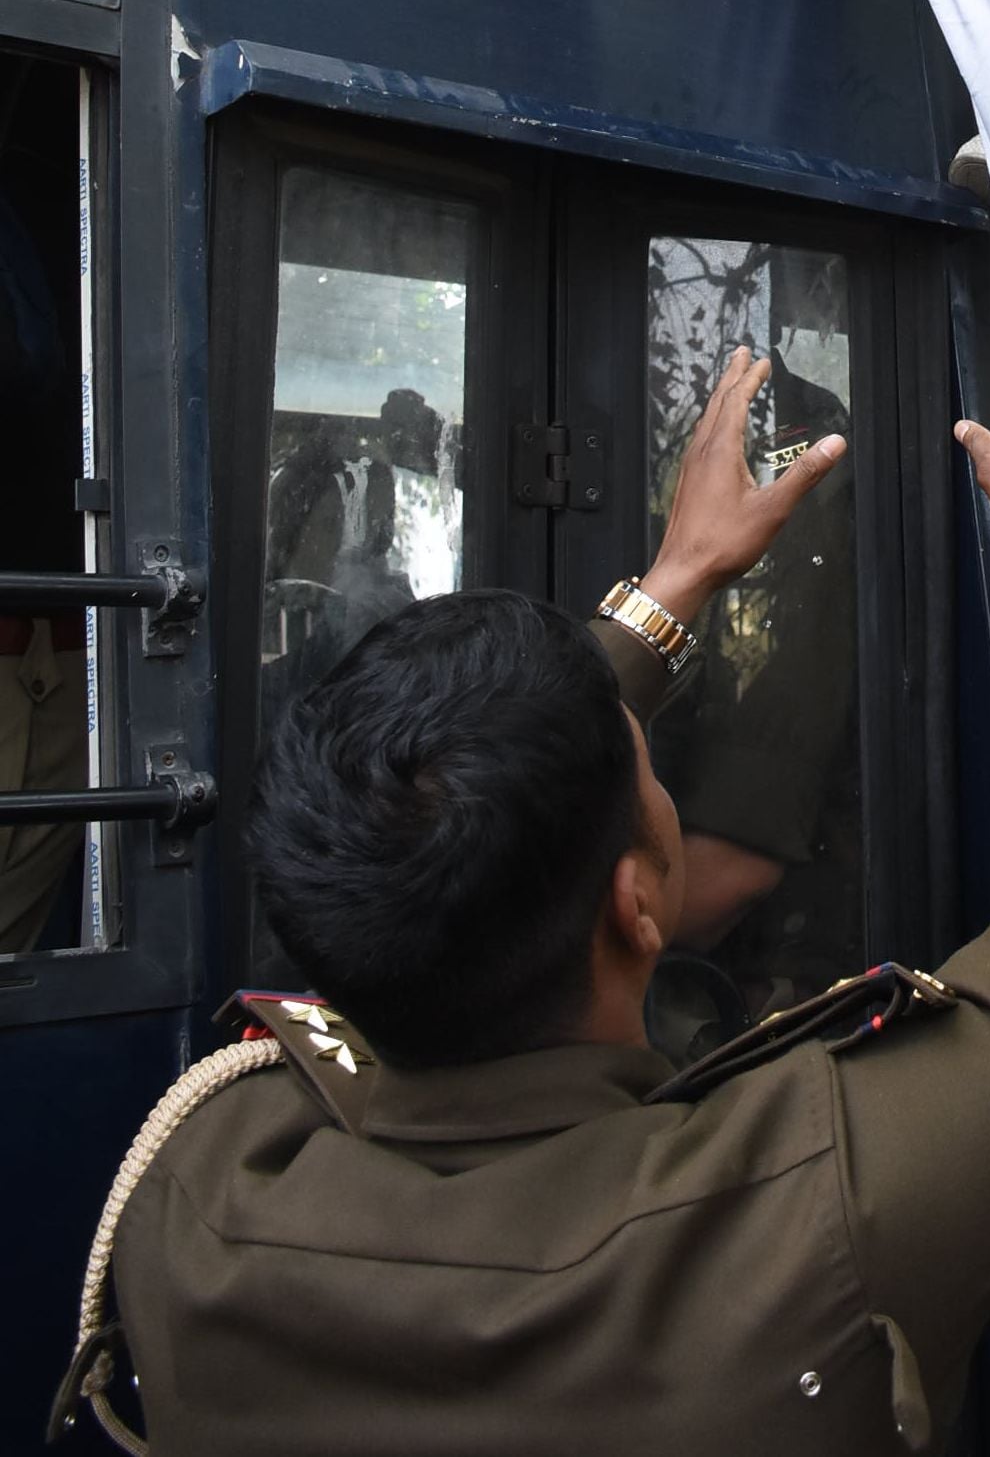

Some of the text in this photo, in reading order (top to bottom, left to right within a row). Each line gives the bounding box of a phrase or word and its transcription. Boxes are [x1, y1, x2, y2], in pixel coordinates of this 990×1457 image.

[79, 158, 88, 277] AARTI SPECTRA
[83, 426, 91, 479] SPECT
[87, 658, 96, 734] SPECTRA
[89, 843, 99, 891] AARTI
